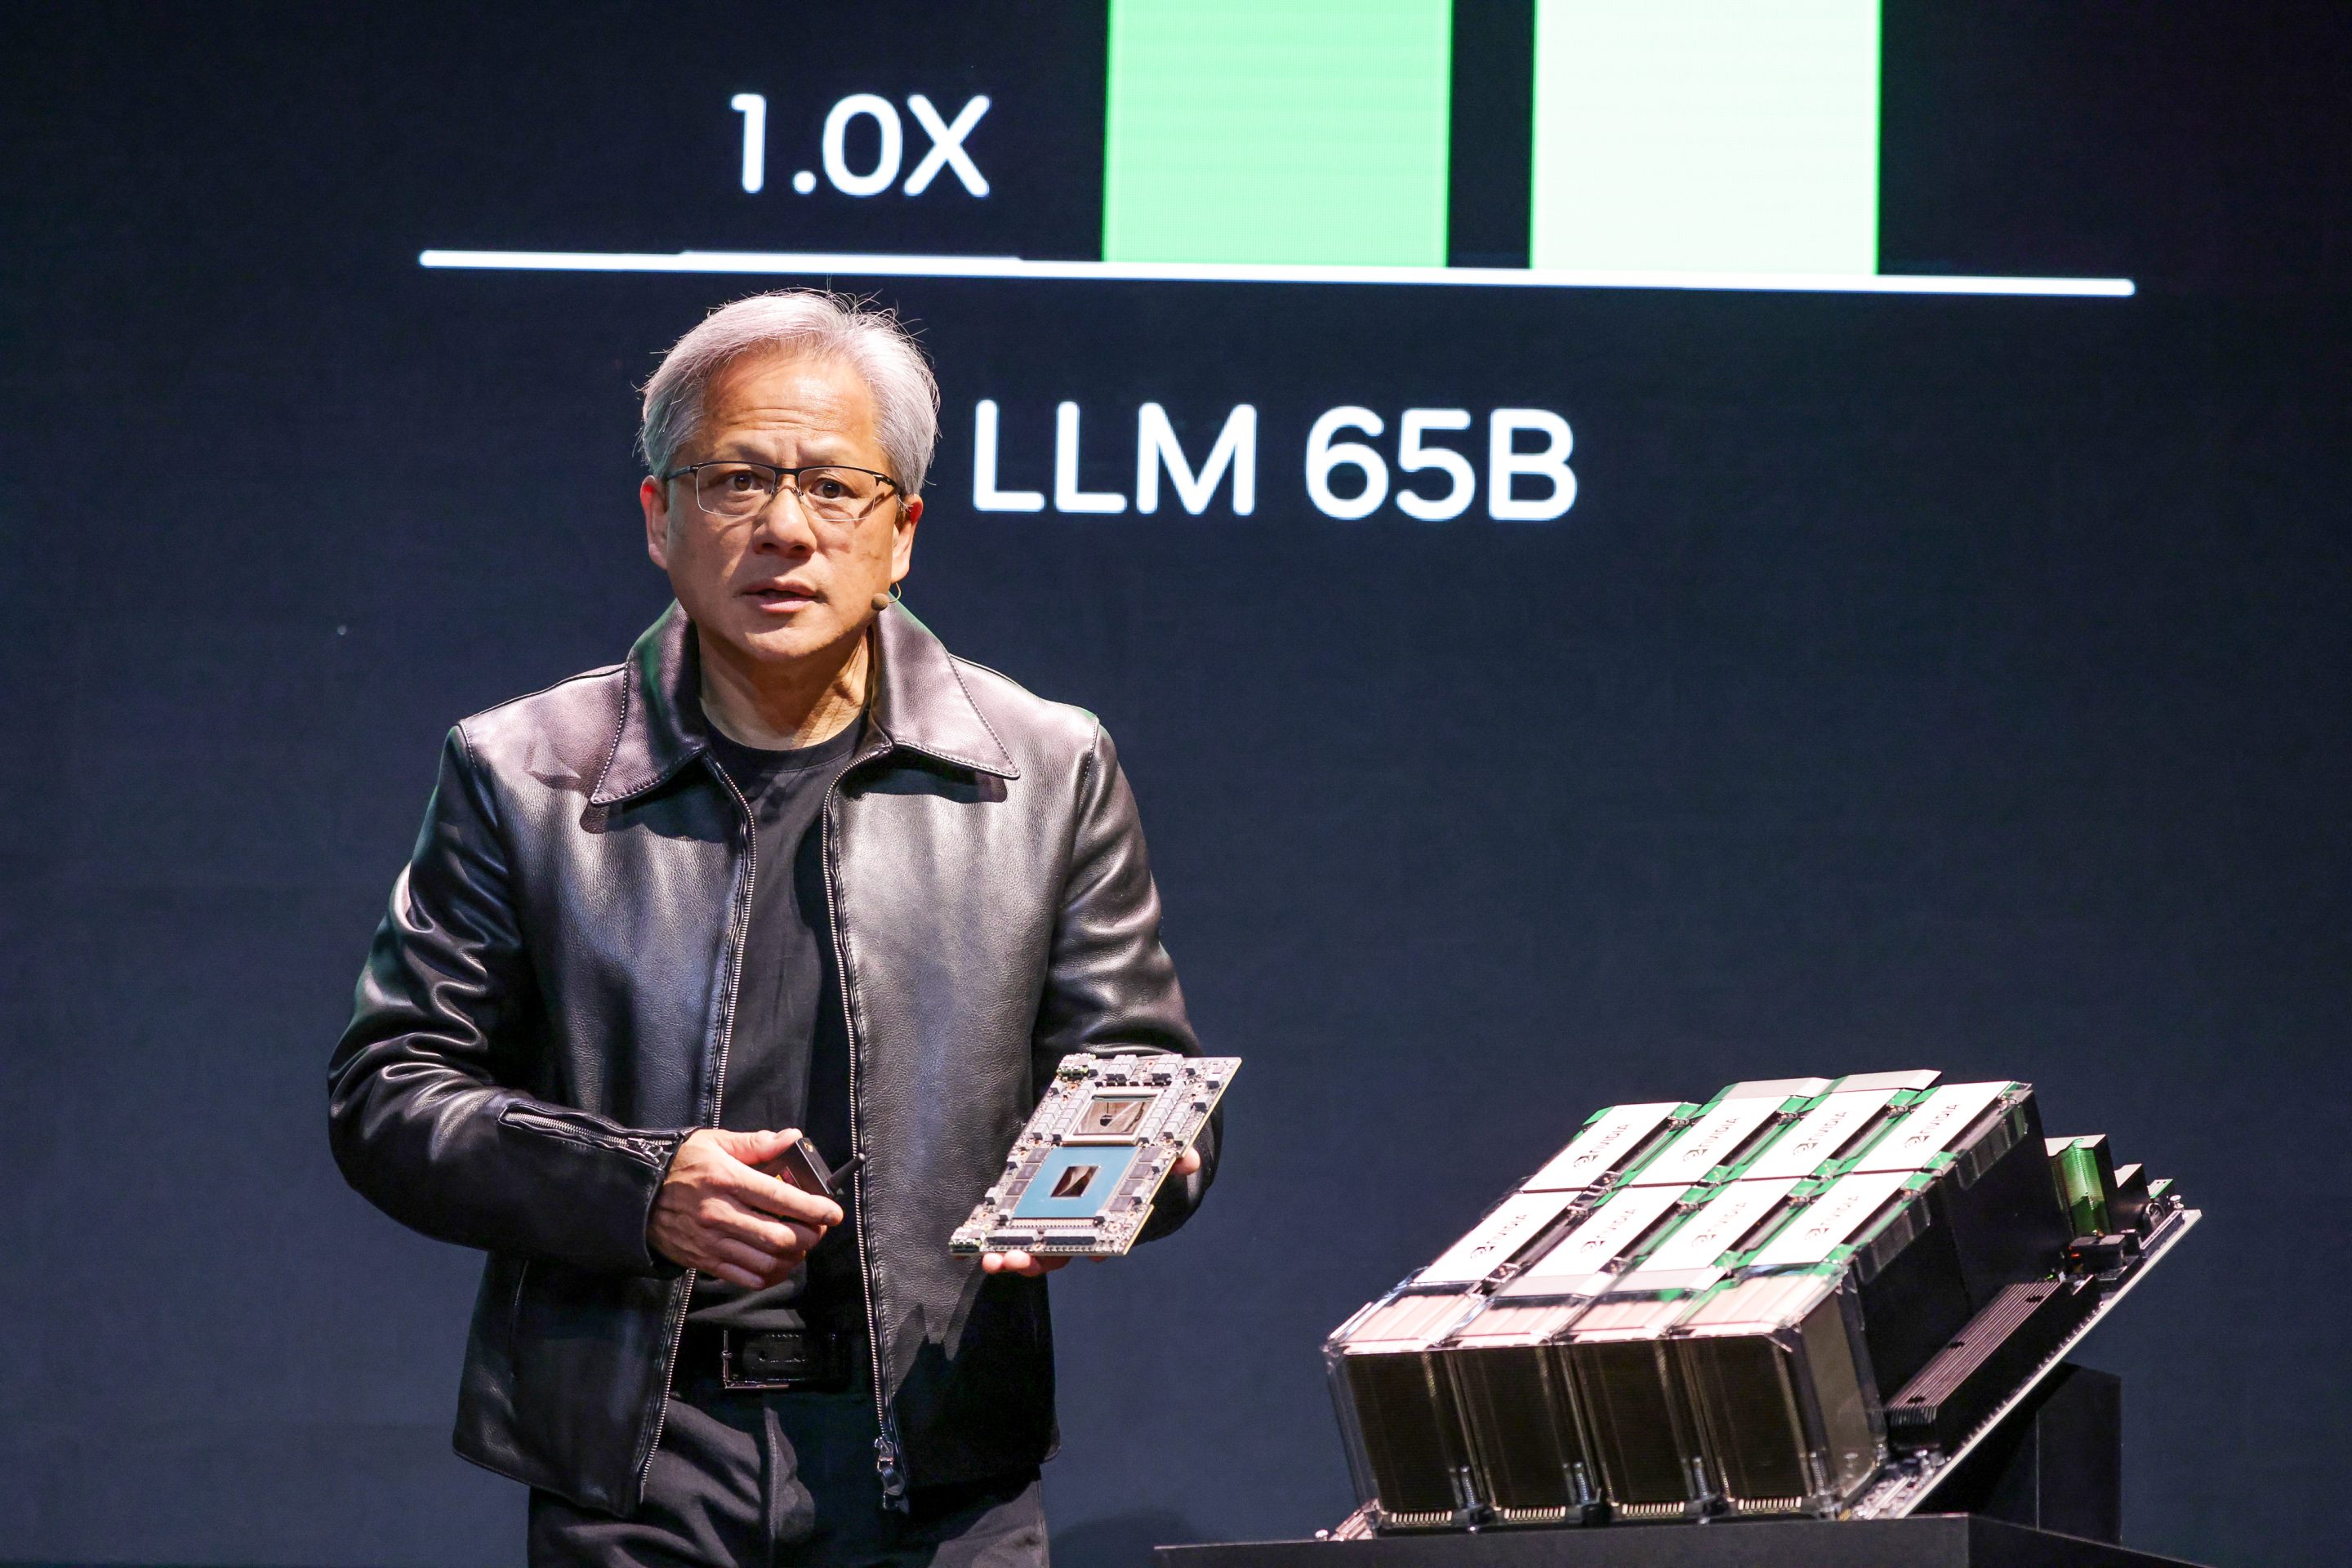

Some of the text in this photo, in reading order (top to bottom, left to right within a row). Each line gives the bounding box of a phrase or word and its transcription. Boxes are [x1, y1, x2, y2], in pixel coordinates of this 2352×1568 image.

[730, 92, 991, 198] 1.0X
[972, 398, 1579, 523] LLM 65B
